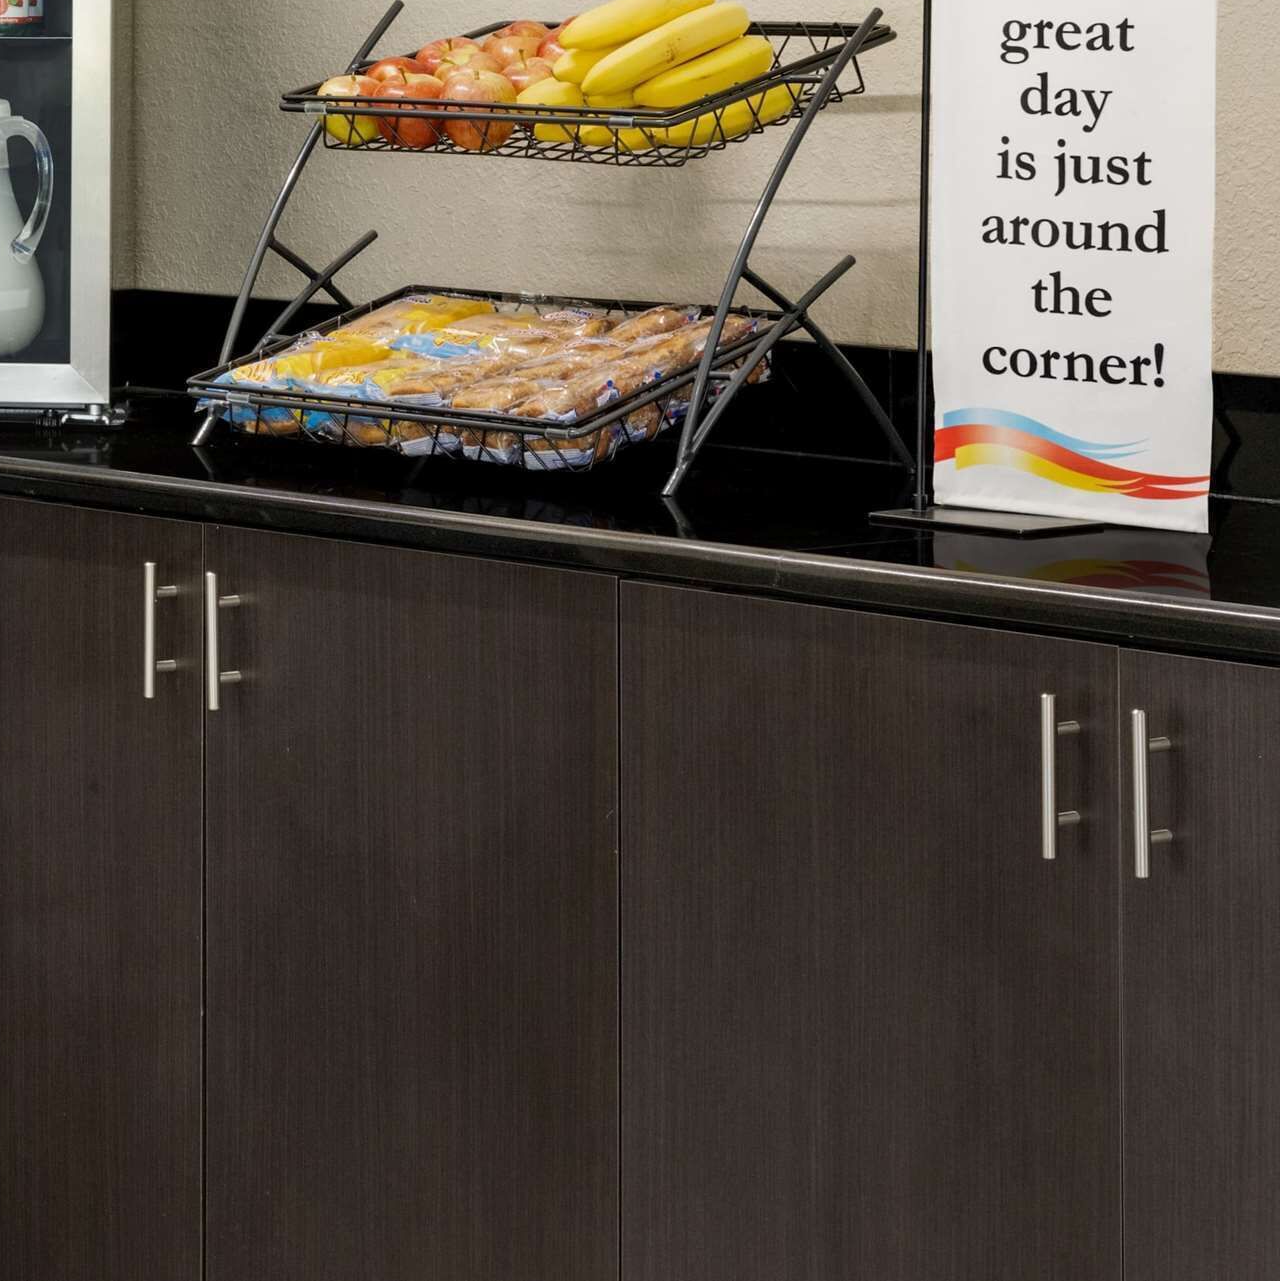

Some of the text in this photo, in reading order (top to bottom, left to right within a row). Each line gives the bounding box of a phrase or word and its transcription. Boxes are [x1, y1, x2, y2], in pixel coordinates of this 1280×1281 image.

[1000, 17, 1135, 65] great
[1020, 72, 1113, 133] day
[996, 136, 1152, 197] is just
[982, 209, 1169, 254] around
[1031, 271, 1112, 318] the
[982, 343, 1165, 388] corner!
